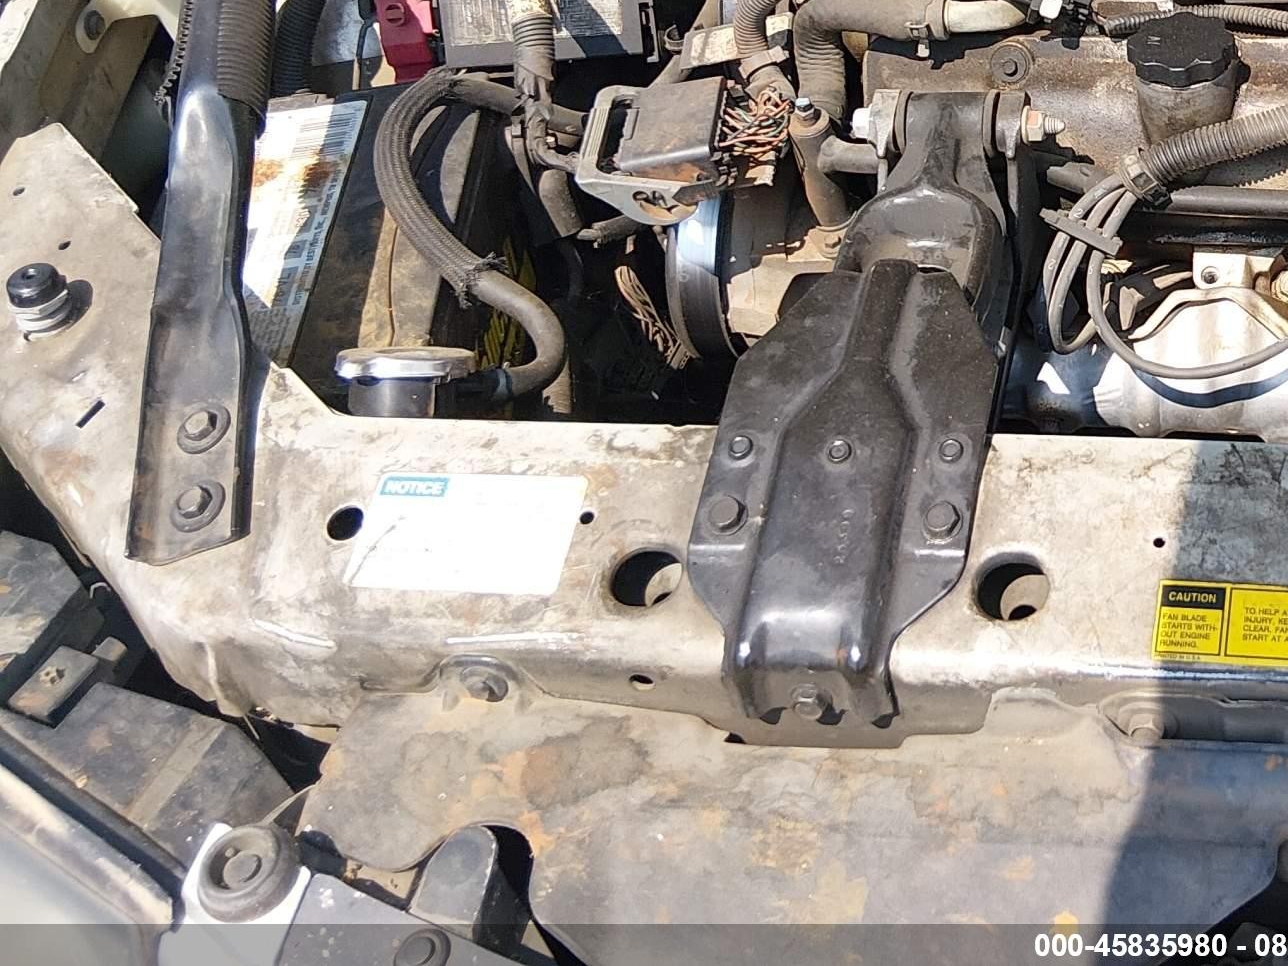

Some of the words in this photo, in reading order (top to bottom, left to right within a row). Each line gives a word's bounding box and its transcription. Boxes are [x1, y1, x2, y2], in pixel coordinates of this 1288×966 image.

[385, 480, 445, 496] NOTICE
[1168, 591, 1217, 603] CAUTION
[1244, 607, 1256, 615] TO
[1258, 608, 1280, 616] HELP
[1162, 613, 1178, 621] FAN
[1181, 614, 1207, 622] BLADE
[1161, 622, 1193, 630] STARTS
[1160, 630, 1177, 638] OUT
[1180, 631, 1211, 640] ENGINE
[1242, 633, 1268, 642] START
